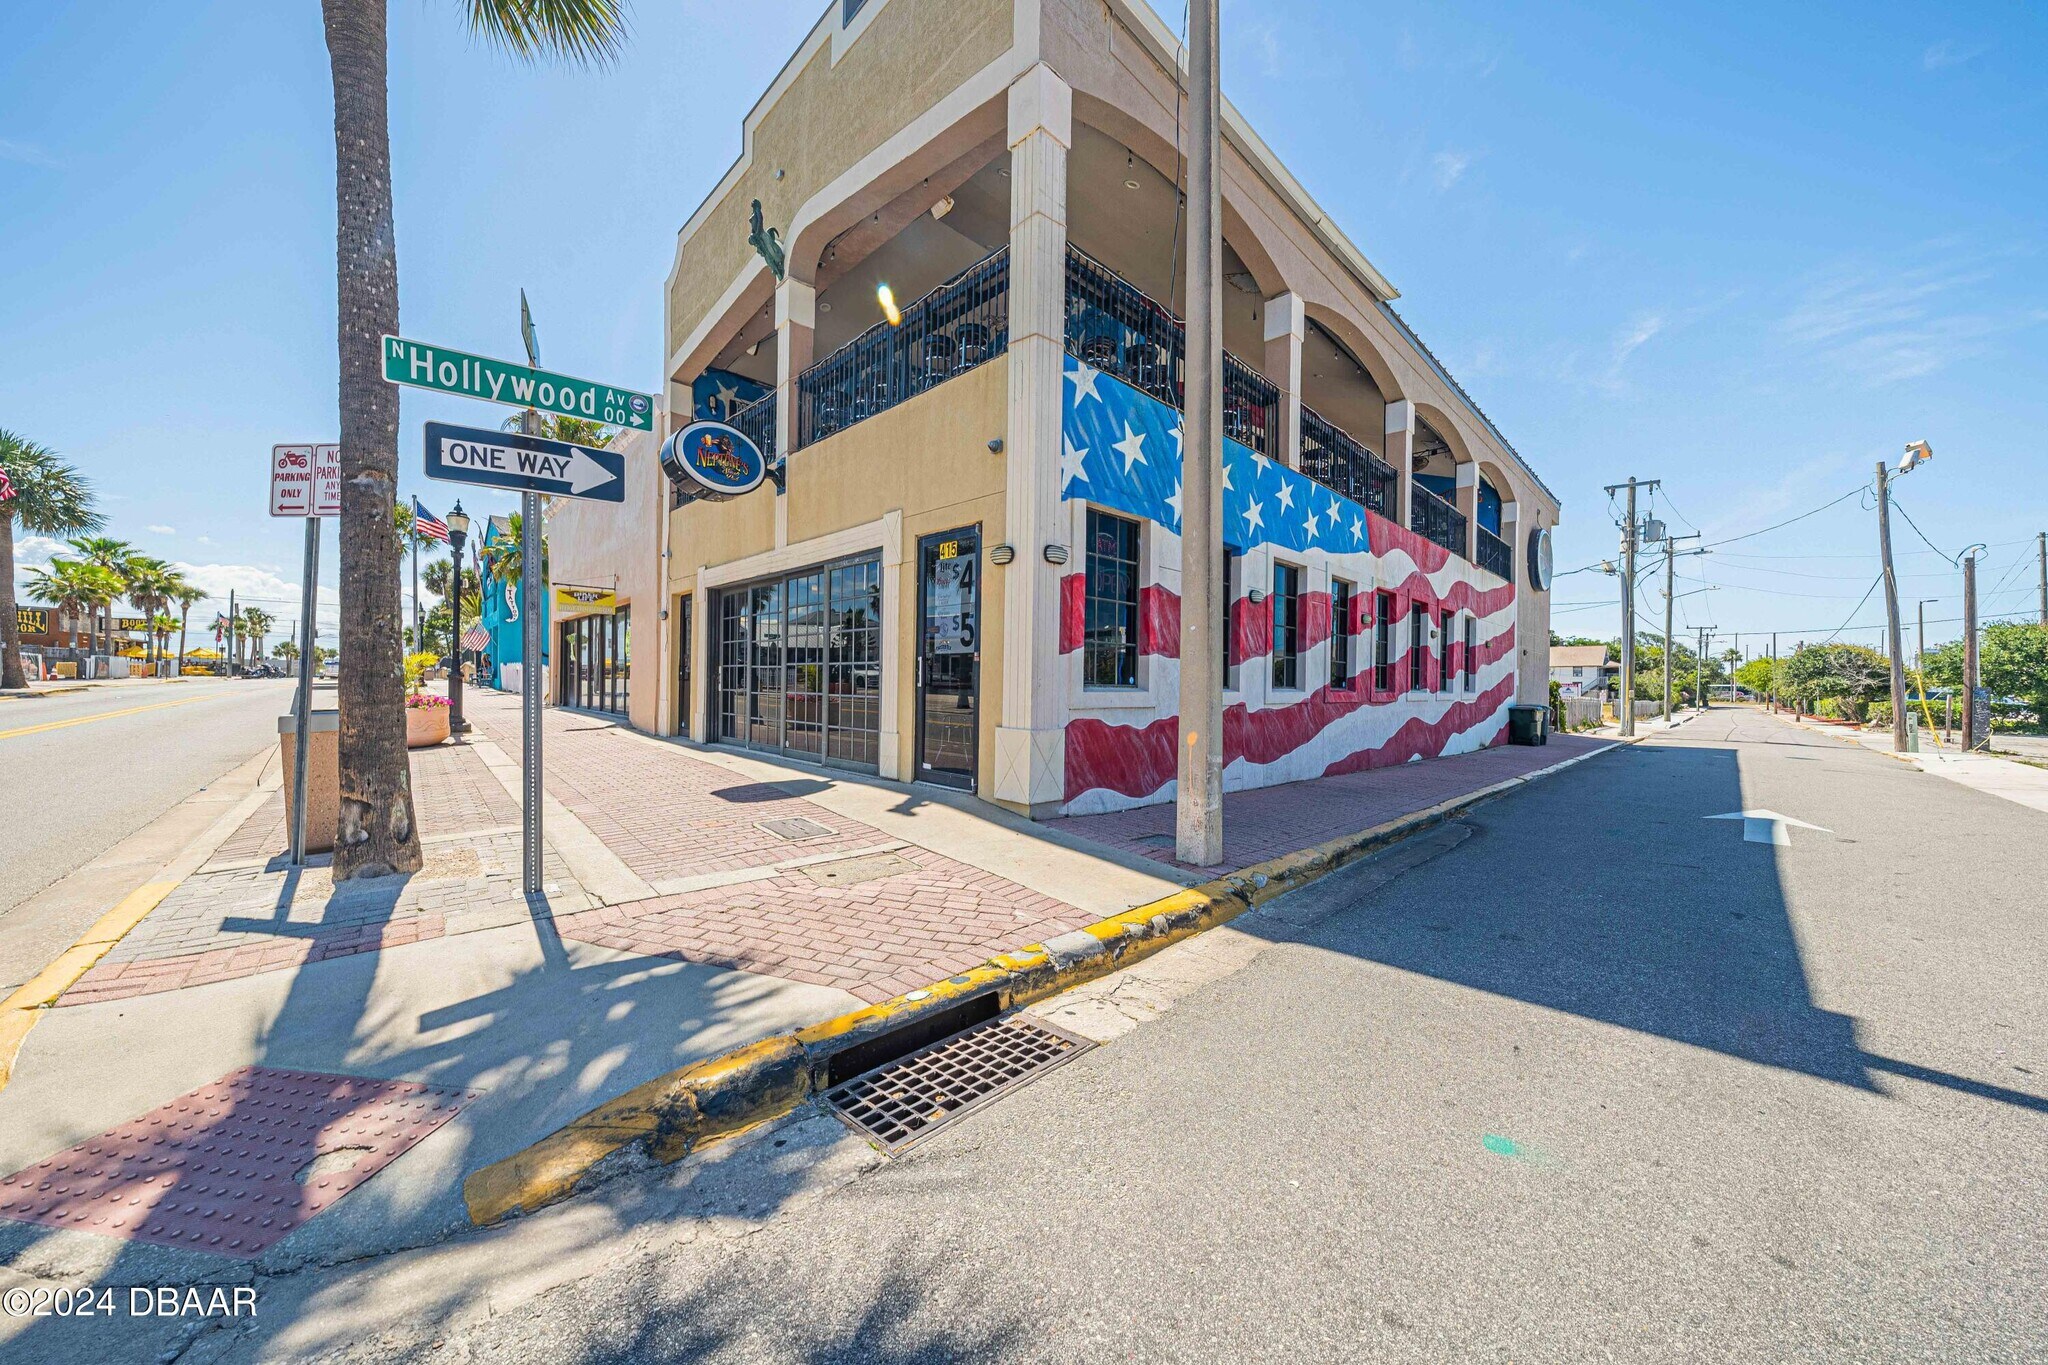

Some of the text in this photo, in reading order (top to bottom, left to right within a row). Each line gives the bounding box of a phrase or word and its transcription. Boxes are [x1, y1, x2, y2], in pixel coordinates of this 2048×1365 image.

[392, 340, 404, 360] N
[410, 346, 596, 415] Hollywood
[605, 389, 625, 406] Av
[449, 442, 571, 478] ONE WAY
[274, 472, 310, 482] PARKING
[316, 466, 341, 480] PARKI
[325, 481, 341, 490] ANY
[281, 488, 302, 498] ONLY
[324, 491, 341, 501] TIME
[940, 542, 957, 558] 415
[952, 611, 975, 648] $5
